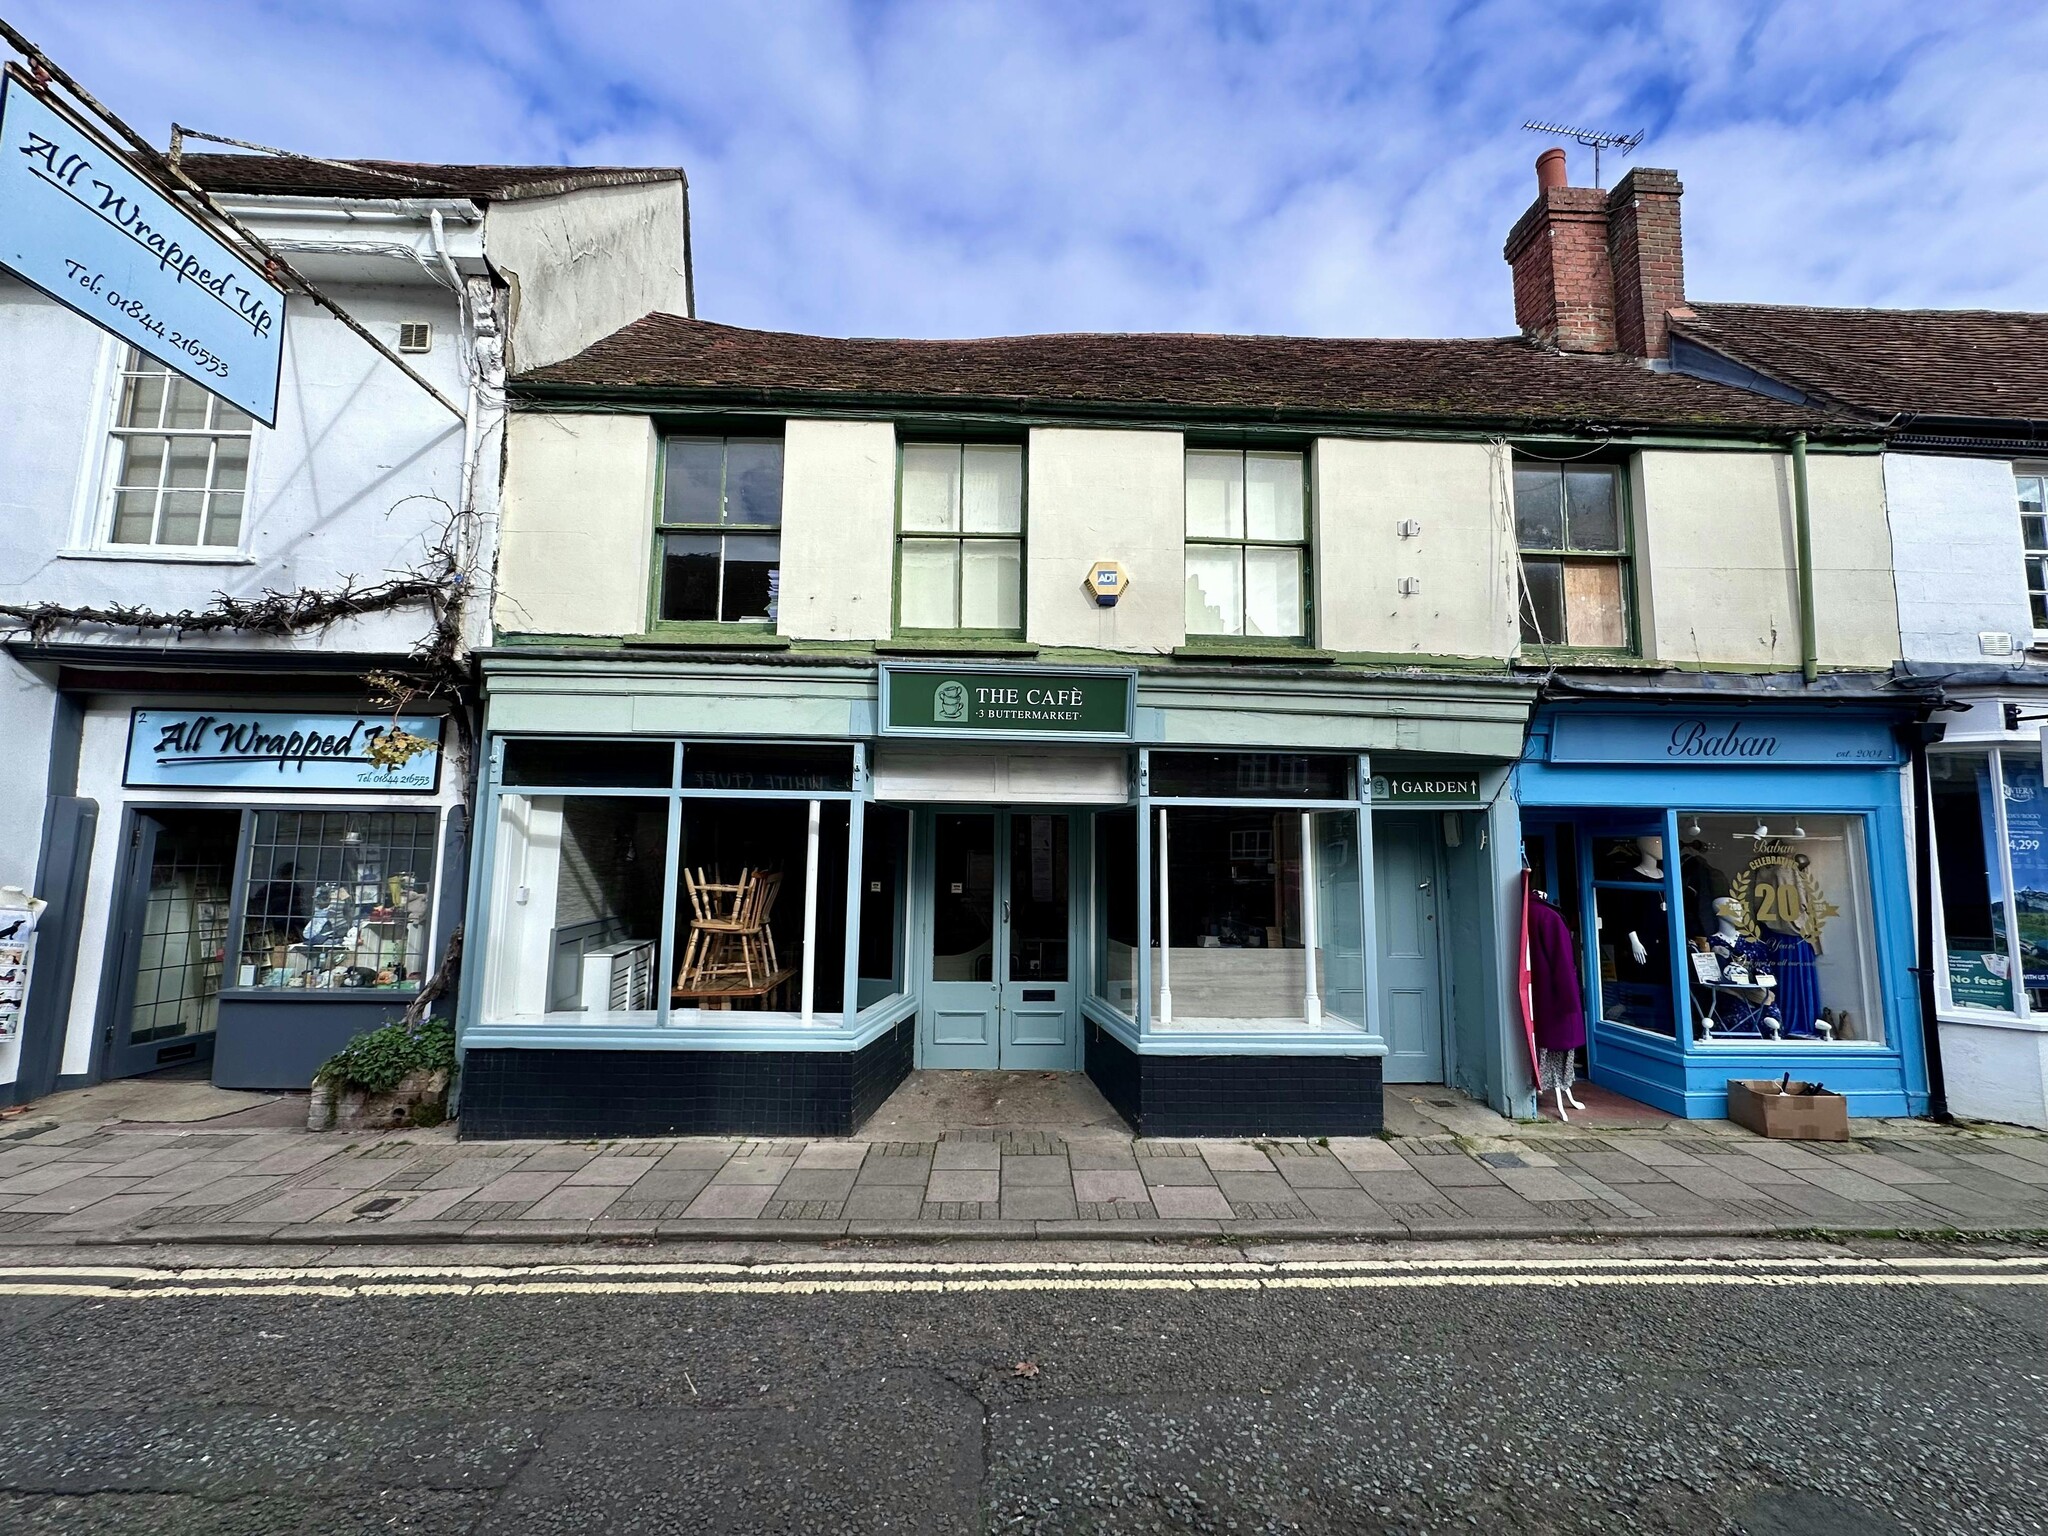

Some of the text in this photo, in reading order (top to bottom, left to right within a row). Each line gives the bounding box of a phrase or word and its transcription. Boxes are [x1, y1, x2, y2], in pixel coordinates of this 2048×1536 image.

[19, 132, 273, 340] All Wrapped Up
[64, 259, 230, 378] Tel: 01844 216553
[1098, 573, 1118, 583] ADT
[975, 686, 1083, 706] THE CAFÈ
[138, 712, 147, 724] 2
[988, 709, 1078, 721] BUTTERMARKET
[153, 715, 216, 752] All
[214, 719, 366, 774] Wrapped
[1667, 719, 1782, 758] Baban
[357, 771, 430, 786] Tel: 01844 216553
[1401, 781, 1468, 793] GARDEN
[1752, 839, 1796, 854] Baban
[1749, 855, 1800, 871] CELEBRATING
[1754, 883, 1800, 922] 20
[1950, 975, 1971, 984] No
[1973, 975, 2004, 986] fees
